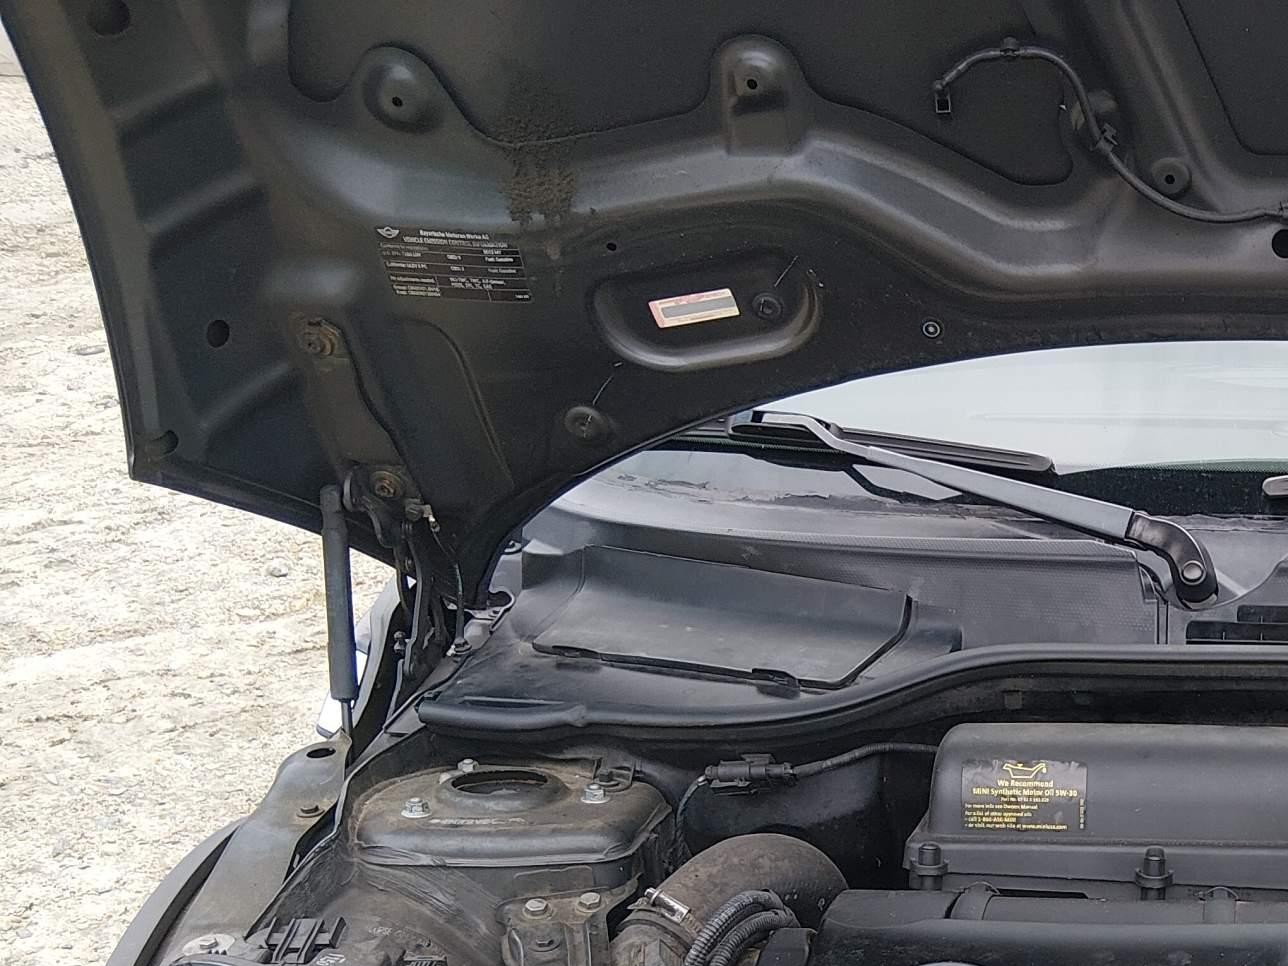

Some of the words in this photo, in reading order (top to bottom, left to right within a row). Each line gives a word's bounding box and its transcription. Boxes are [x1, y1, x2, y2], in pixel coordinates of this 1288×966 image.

[997, 779, 1009, 787] We
[1010, 779, 1053, 788] Recommend
[973, 787, 990, 795] MINI
[991, 788, 1022, 797] Synthetic
[1022, 788, 1043, 796] Motor
[1044, 788, 1054, 796] Oil
[1055, 789, 1078, 797] 5W-30
